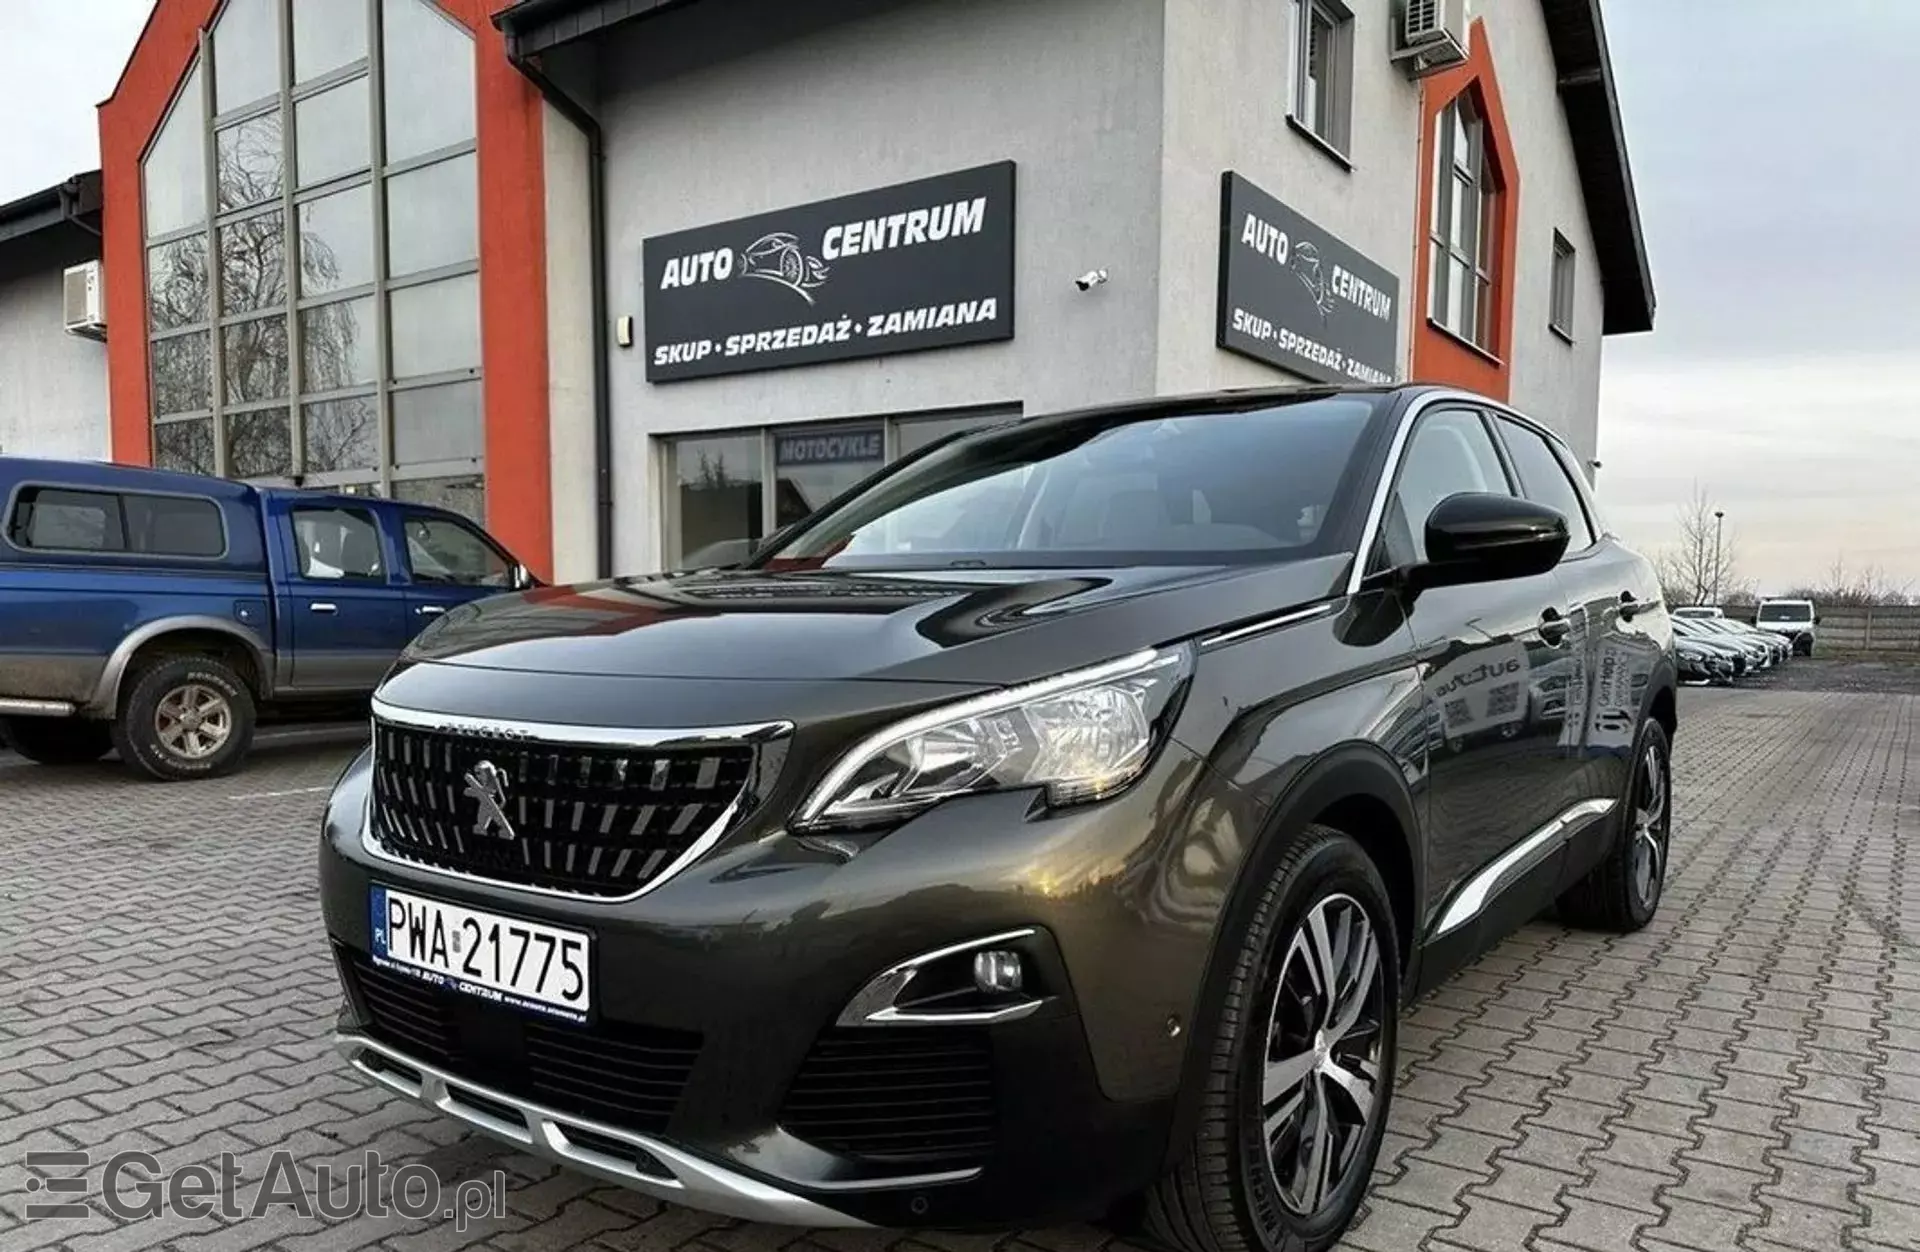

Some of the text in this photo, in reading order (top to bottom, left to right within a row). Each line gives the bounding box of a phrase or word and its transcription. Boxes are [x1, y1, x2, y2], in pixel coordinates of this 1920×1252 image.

[660, 197, 986, 290] AUTO CENTRUM
[1241, 213, 1391, 321] AUTO CENTRUM
[654, 297, 997, 366] SKUP SPRZEDAŻ ZAMIANA
[1232, 308, 1272, 341] SKUP
[780, 434, 880, 461] MOTOCYKLE
